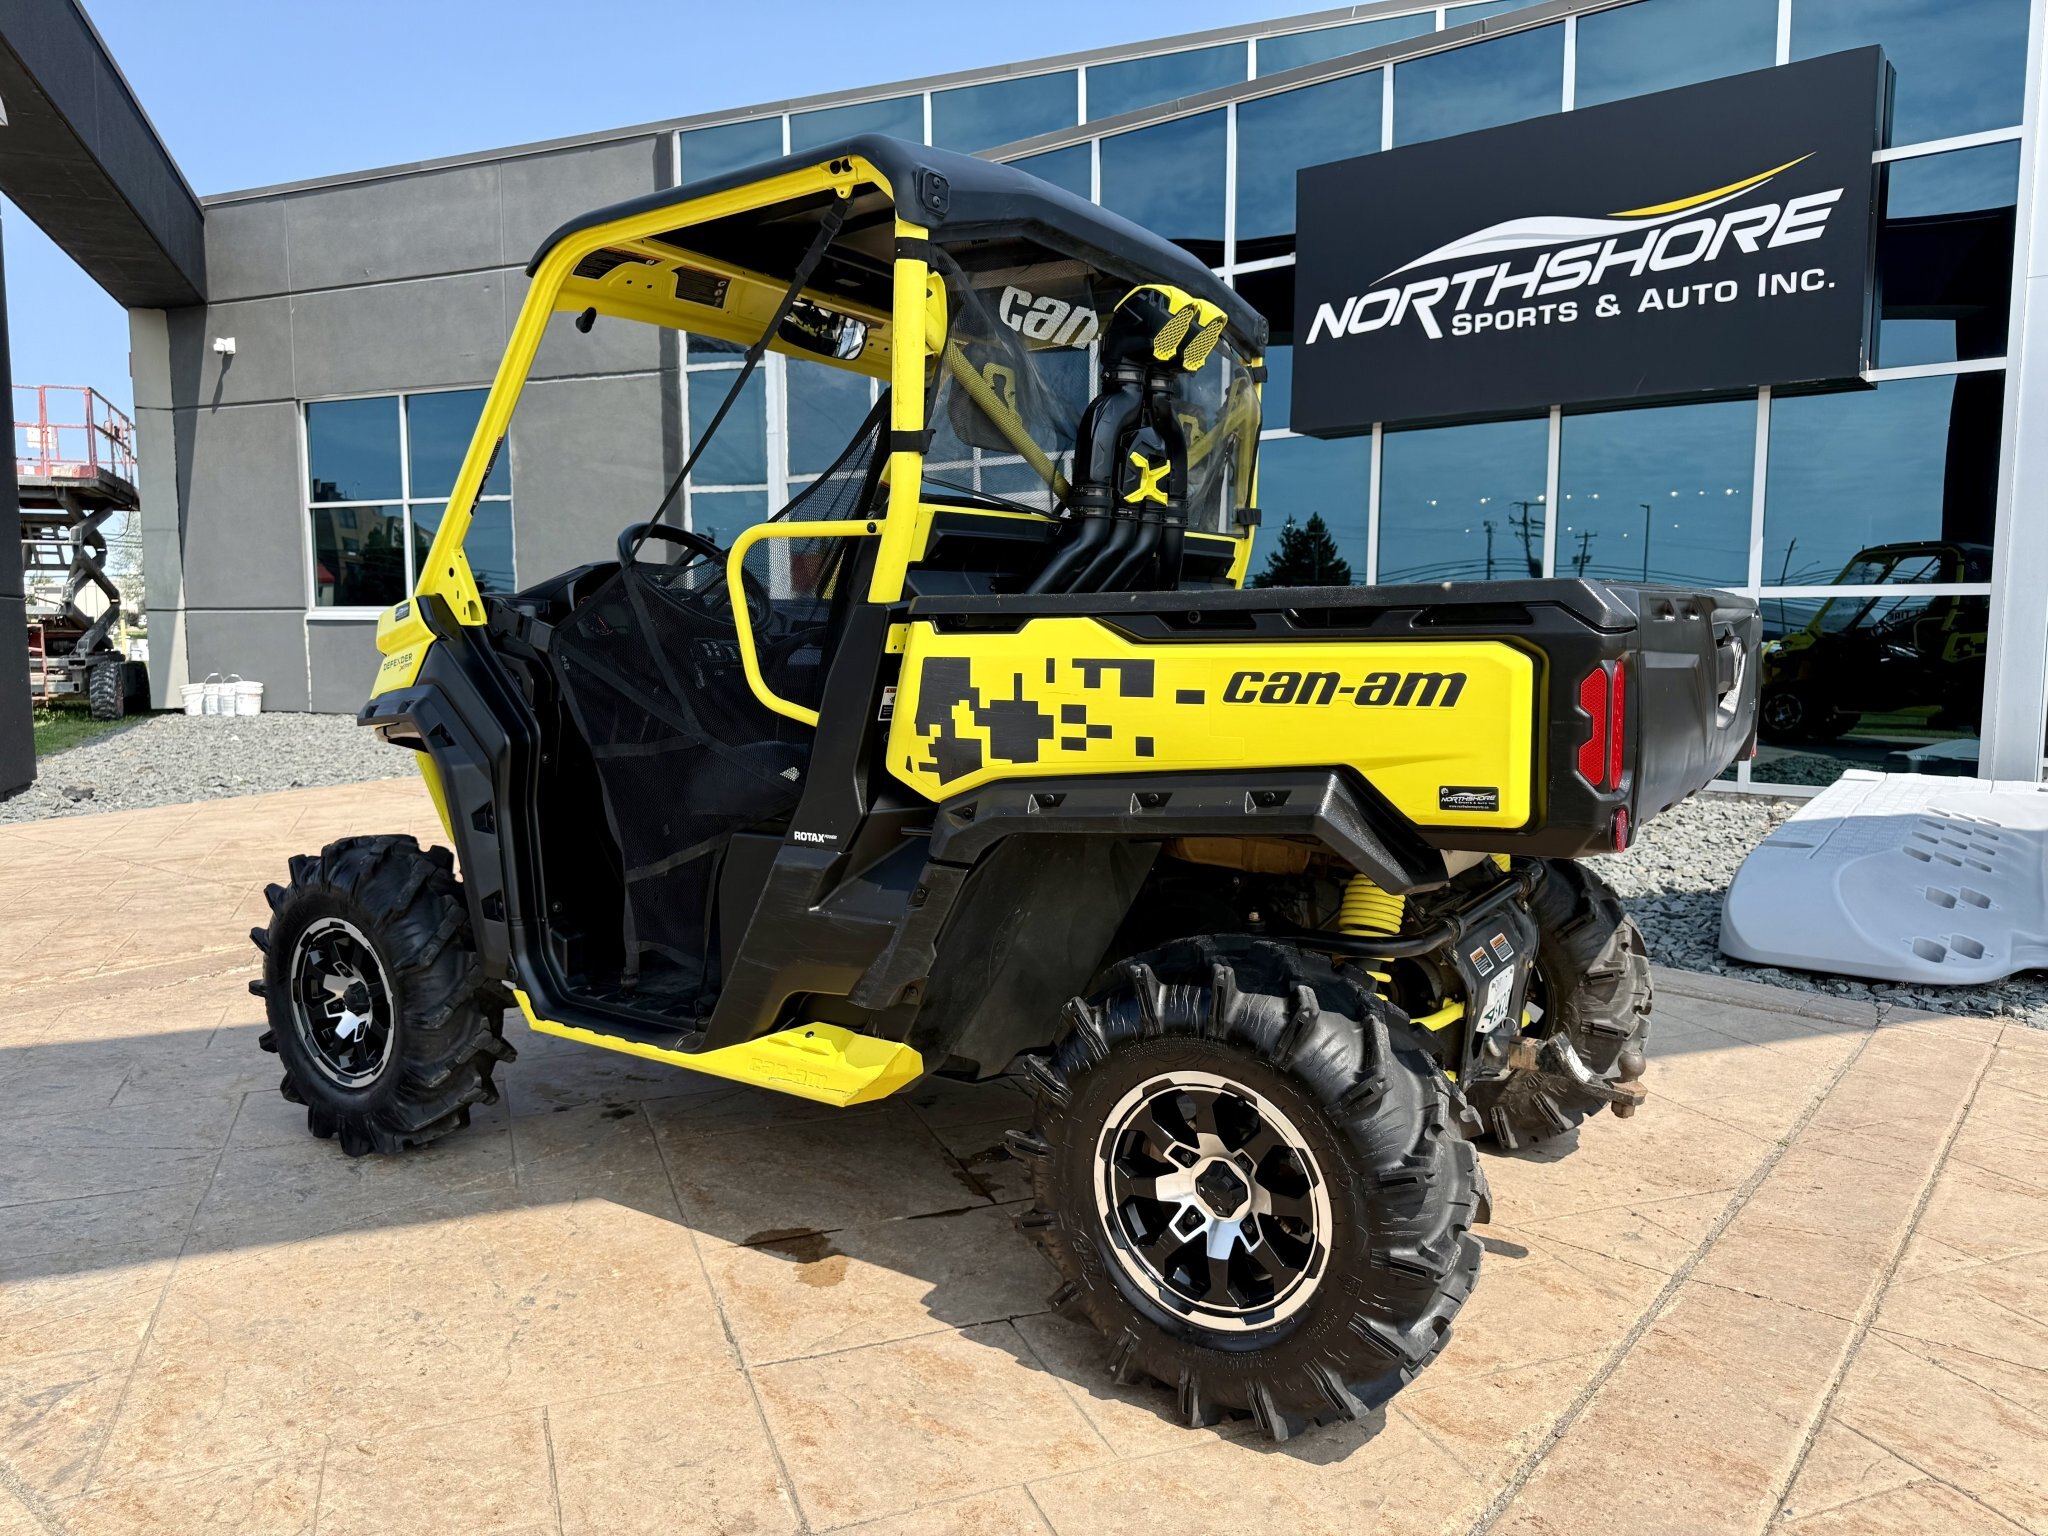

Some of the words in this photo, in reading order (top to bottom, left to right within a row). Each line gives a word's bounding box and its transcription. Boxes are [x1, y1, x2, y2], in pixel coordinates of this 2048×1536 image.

[1306, 188, 1843, 344] NORTHSHORE
[1452, 302, 1578, 336] SPORTS
[1596, 294, 1621, 317] &
[1638, 281, 1738, 313] AUTO
[1758, 269, 1836, 298] INC.
[383, 652, 412, 671] DEFENDER
[1223, 671, 1467, 707] can-am
[1441, 795, 1496, 803] NORTHSHORE
[794, 831, 824, 843] ROTAX
